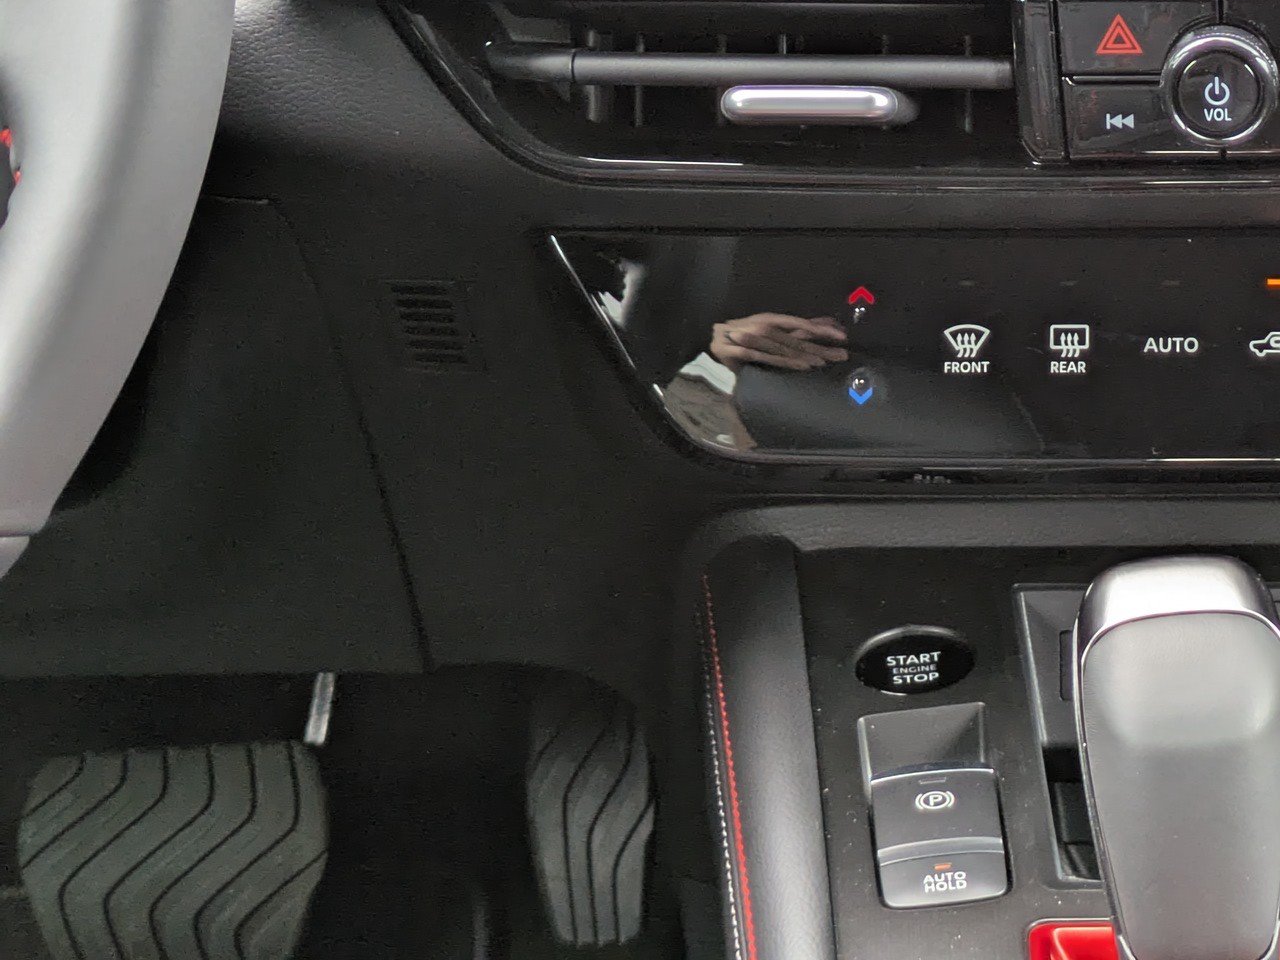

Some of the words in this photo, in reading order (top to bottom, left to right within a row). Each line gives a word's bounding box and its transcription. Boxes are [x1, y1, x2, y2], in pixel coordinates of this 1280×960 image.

[1203, 107, 1232, 122] VOL
[1143, 337, 1199, 353] AUTO
[943, 361, 990, 374] FRONT
[1050, 360, 1086, 374] REAR
[886, 651, 942, 667] START
[892, 664, 937, 674] ENGINE
[892, 672, 940, 685] STOP
[923, 871, 967, 884] AUTO
[924, 879, 967, 893] HOLD
